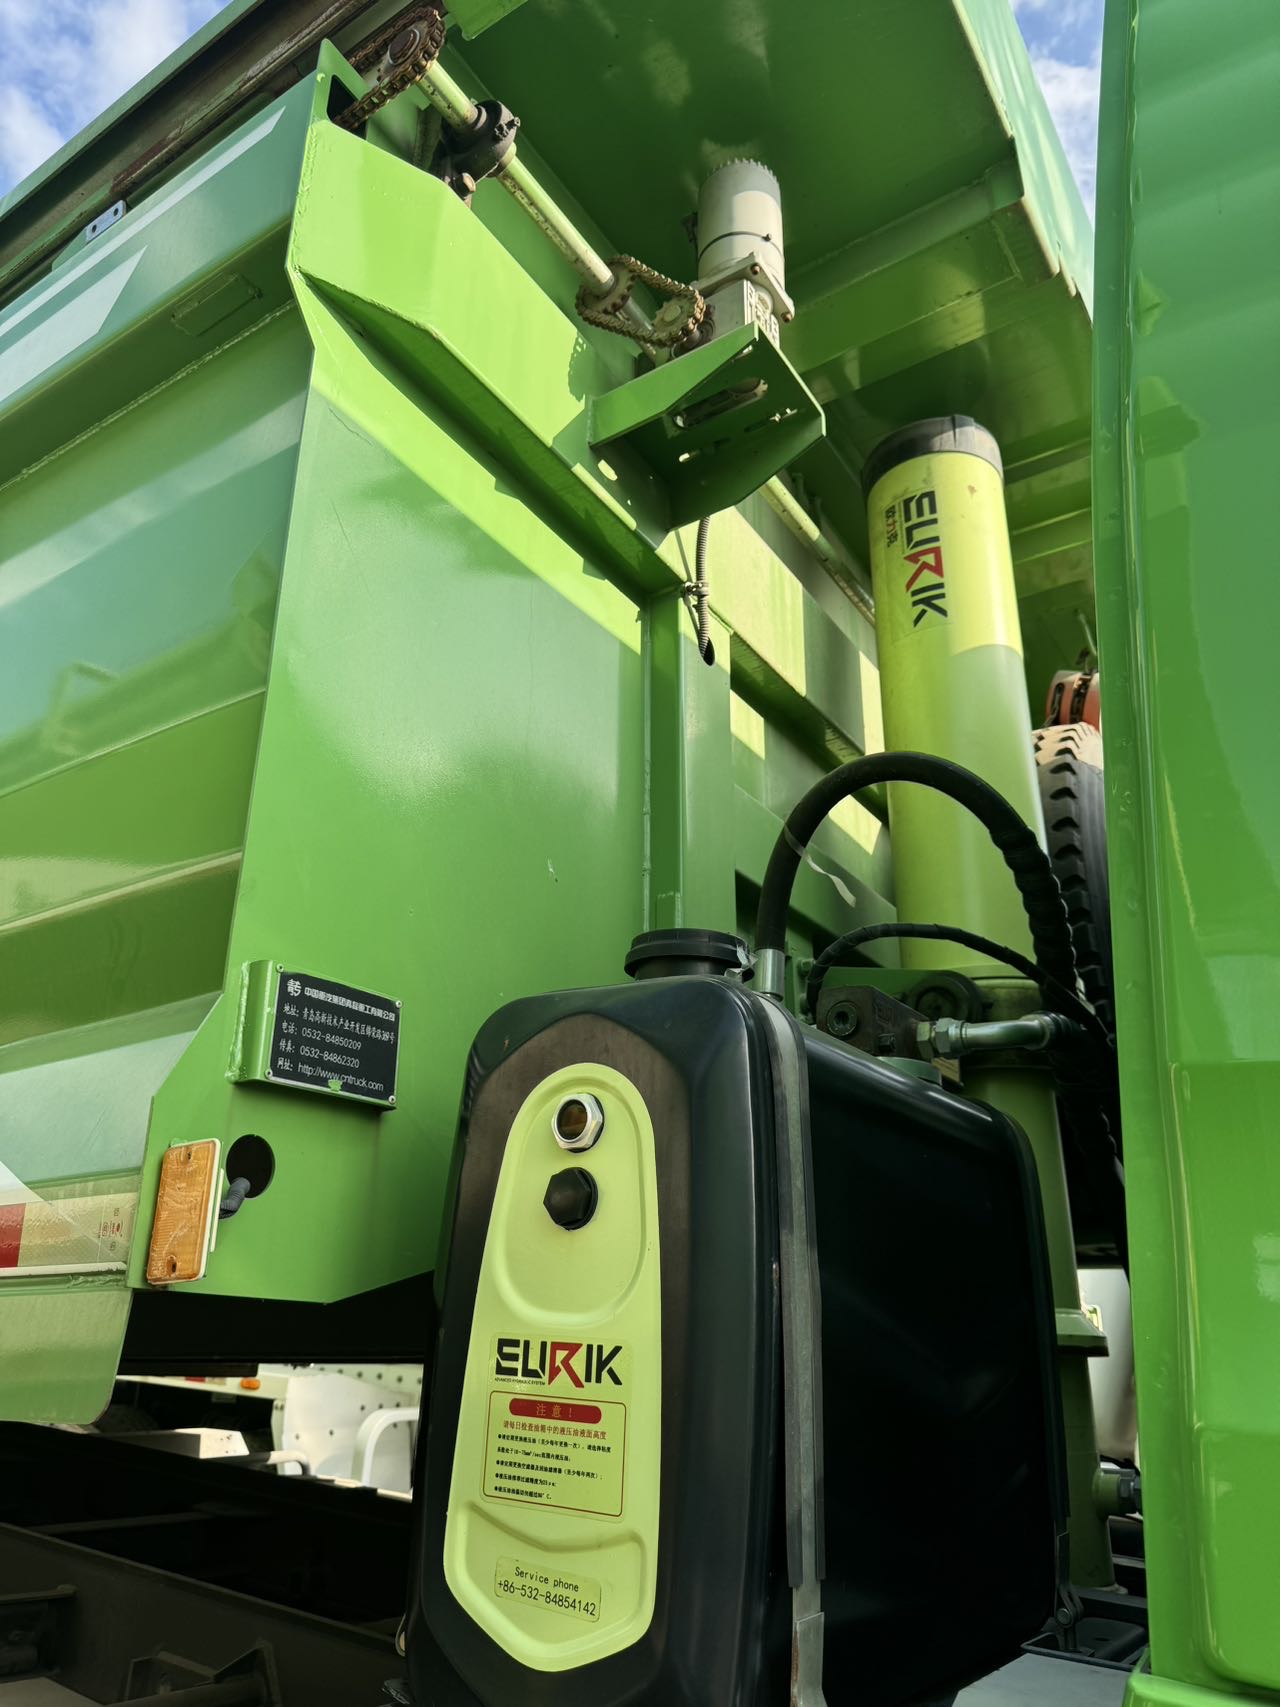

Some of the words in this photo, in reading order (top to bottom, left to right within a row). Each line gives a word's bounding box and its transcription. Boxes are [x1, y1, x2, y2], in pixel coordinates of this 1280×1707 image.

[903, 490, 949, 628] EURIK
[301, 1027, 362, 1051] 0532-84850209
[299, 1045, 360, 1069] 0532-84862320
[495, 1337, 623, 1389] EURIK
[514, 1566, 549, 1584] Service
[553, 1578, 580, 1593] phone
[497, 1579, 596, 1616] +86-532-84854142
